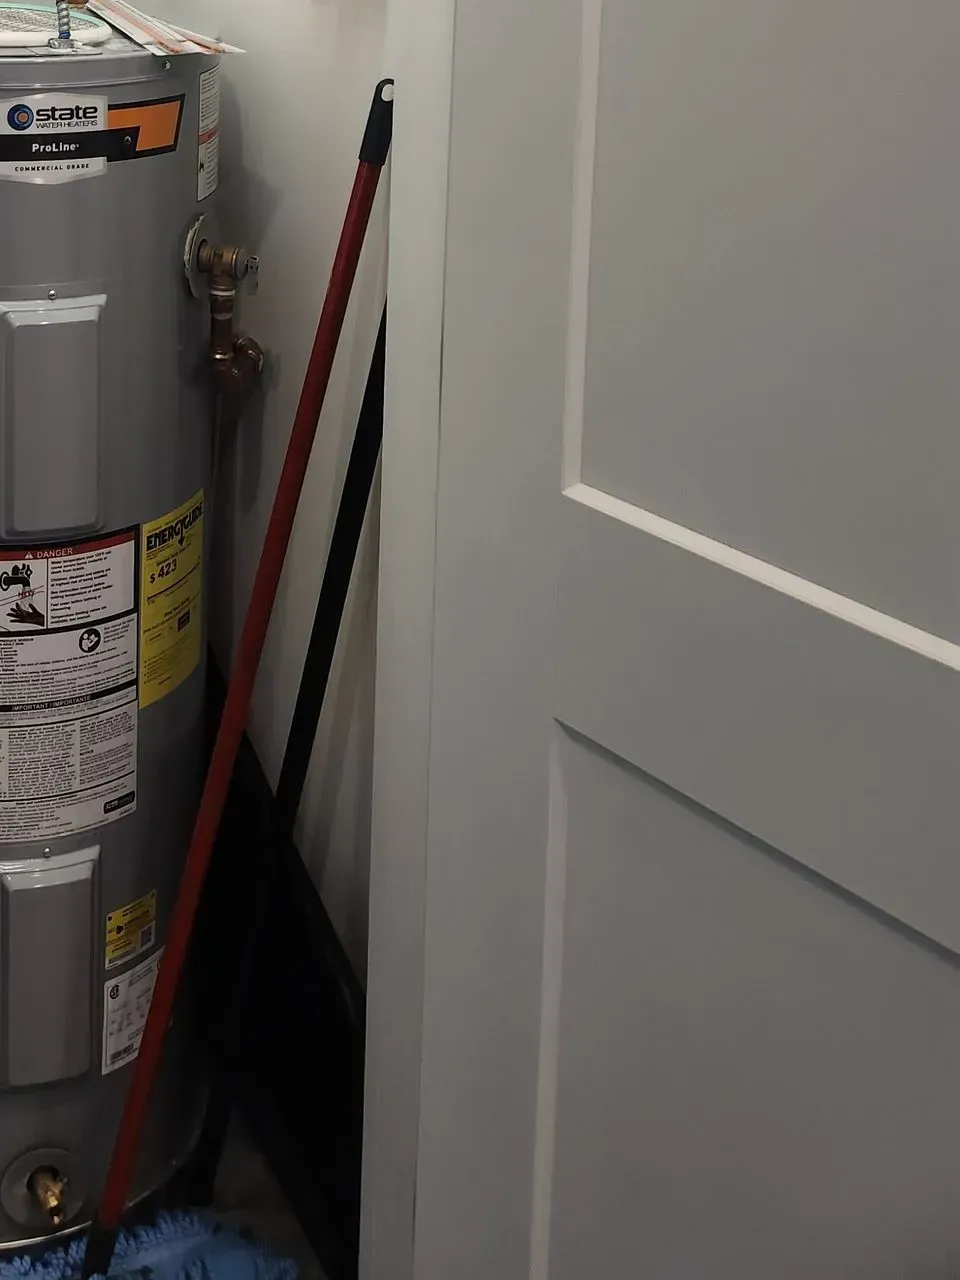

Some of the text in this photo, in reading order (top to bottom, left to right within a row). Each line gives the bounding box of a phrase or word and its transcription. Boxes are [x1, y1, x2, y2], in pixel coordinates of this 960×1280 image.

[36, 105, 98, 121] state
[63, 120, 98, 128] HEATERS
[14, 164, 63, 172] COMMERCIAL
[36, 548, 73, 559] DANGER
[150, 558, 177, 584] $ 423
